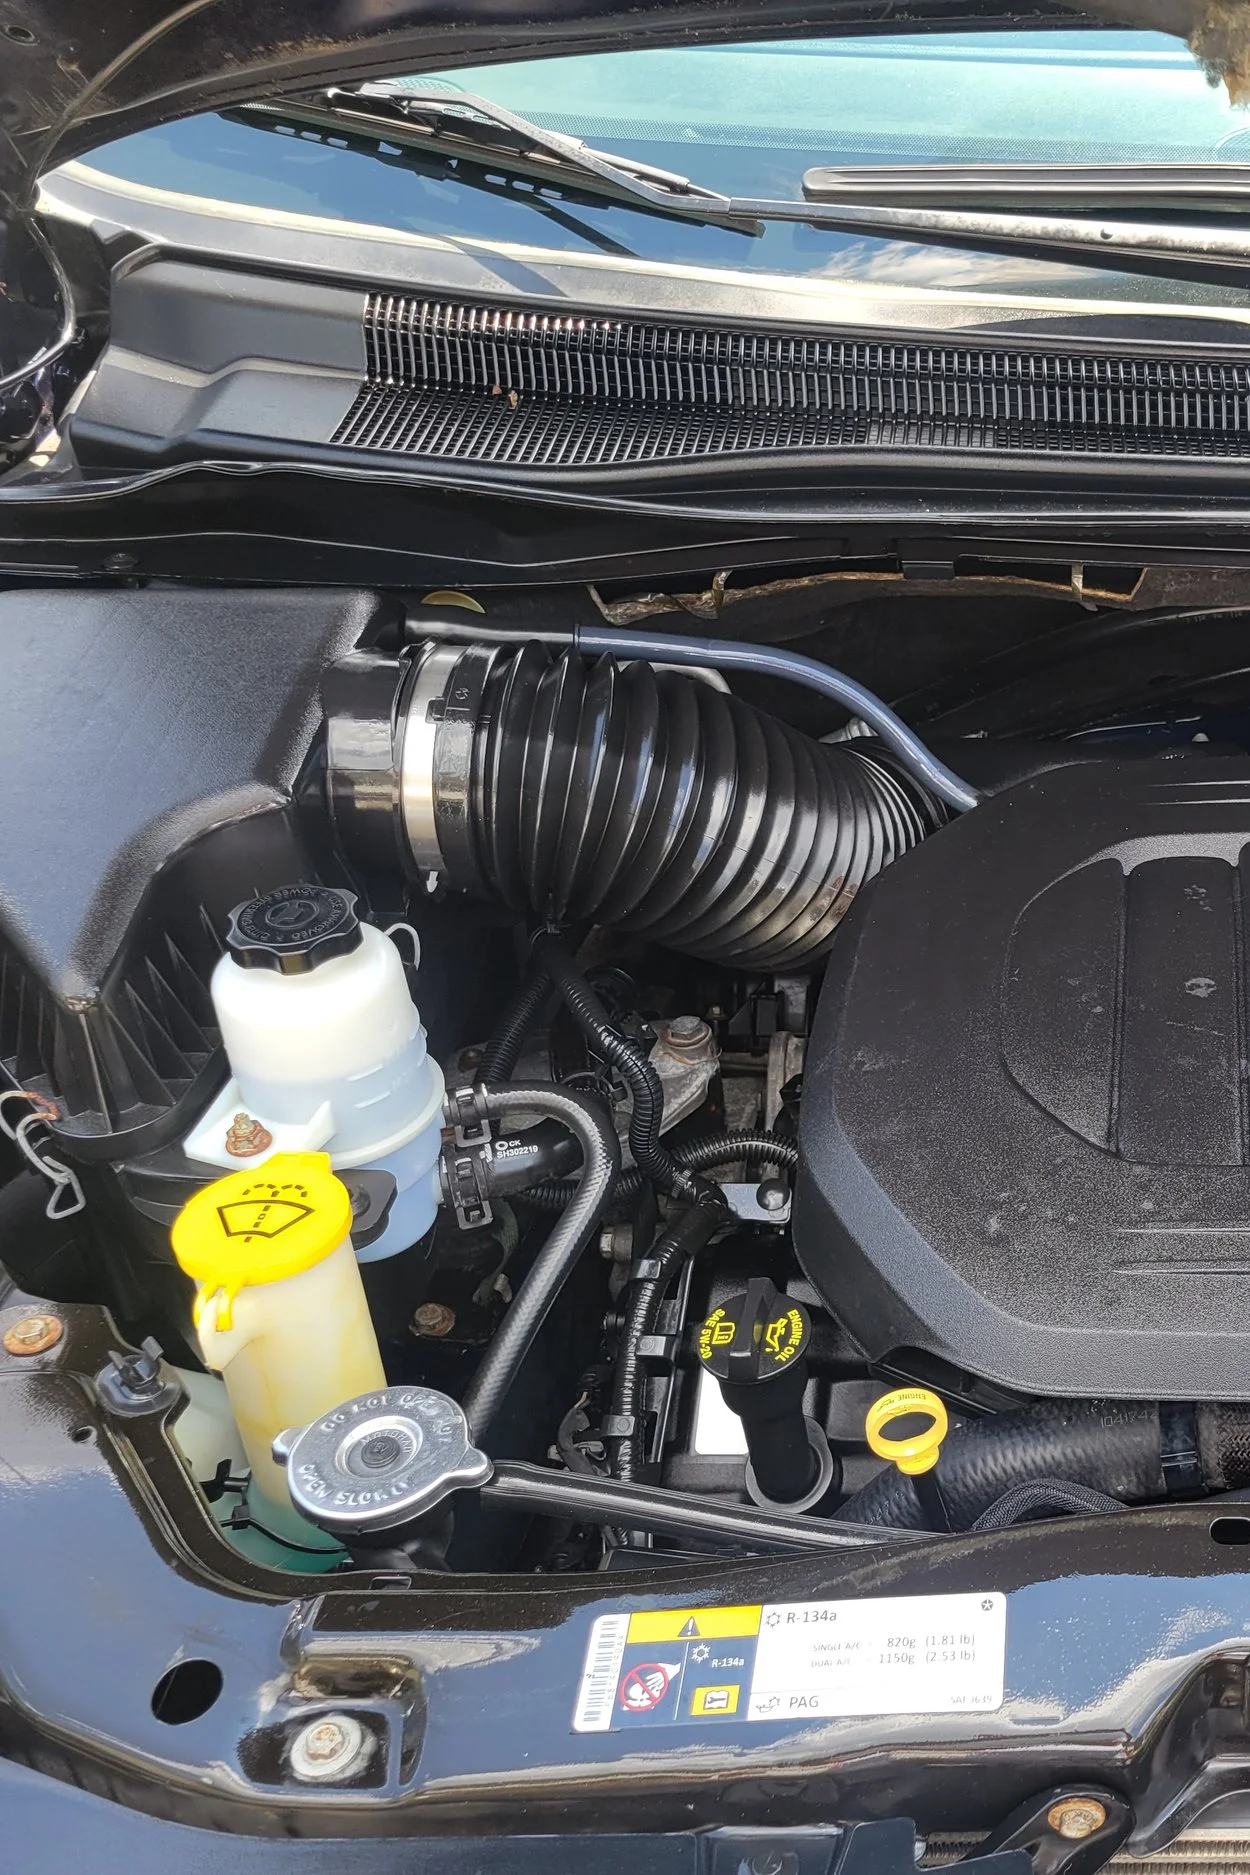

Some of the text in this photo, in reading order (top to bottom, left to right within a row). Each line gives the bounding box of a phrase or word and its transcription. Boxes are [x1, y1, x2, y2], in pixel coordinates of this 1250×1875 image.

[700, 1308, 726, 1360] SAE 5W-20
[774, 1309, 803, 1362] ENGINE OIL
[298, 1464, 332, 1498] OPEN
[786, 1610, 838, 1625] R-134a
[813, 1633, 976, 1652] SINGLE A/C 820g (1.81 lb)
[711, 1656, 745, 1668] R-134a
[810, 1658, 834, 1668] DUAL
[878, 1653, 916, 1666] 1150g
[925, 1650, 956, 1664] (2.53
[960, 1650, 976, 1662] lb)
[789, 1695, 820, 1710] PAG
[950, 1696, 967, 1705] SAE
